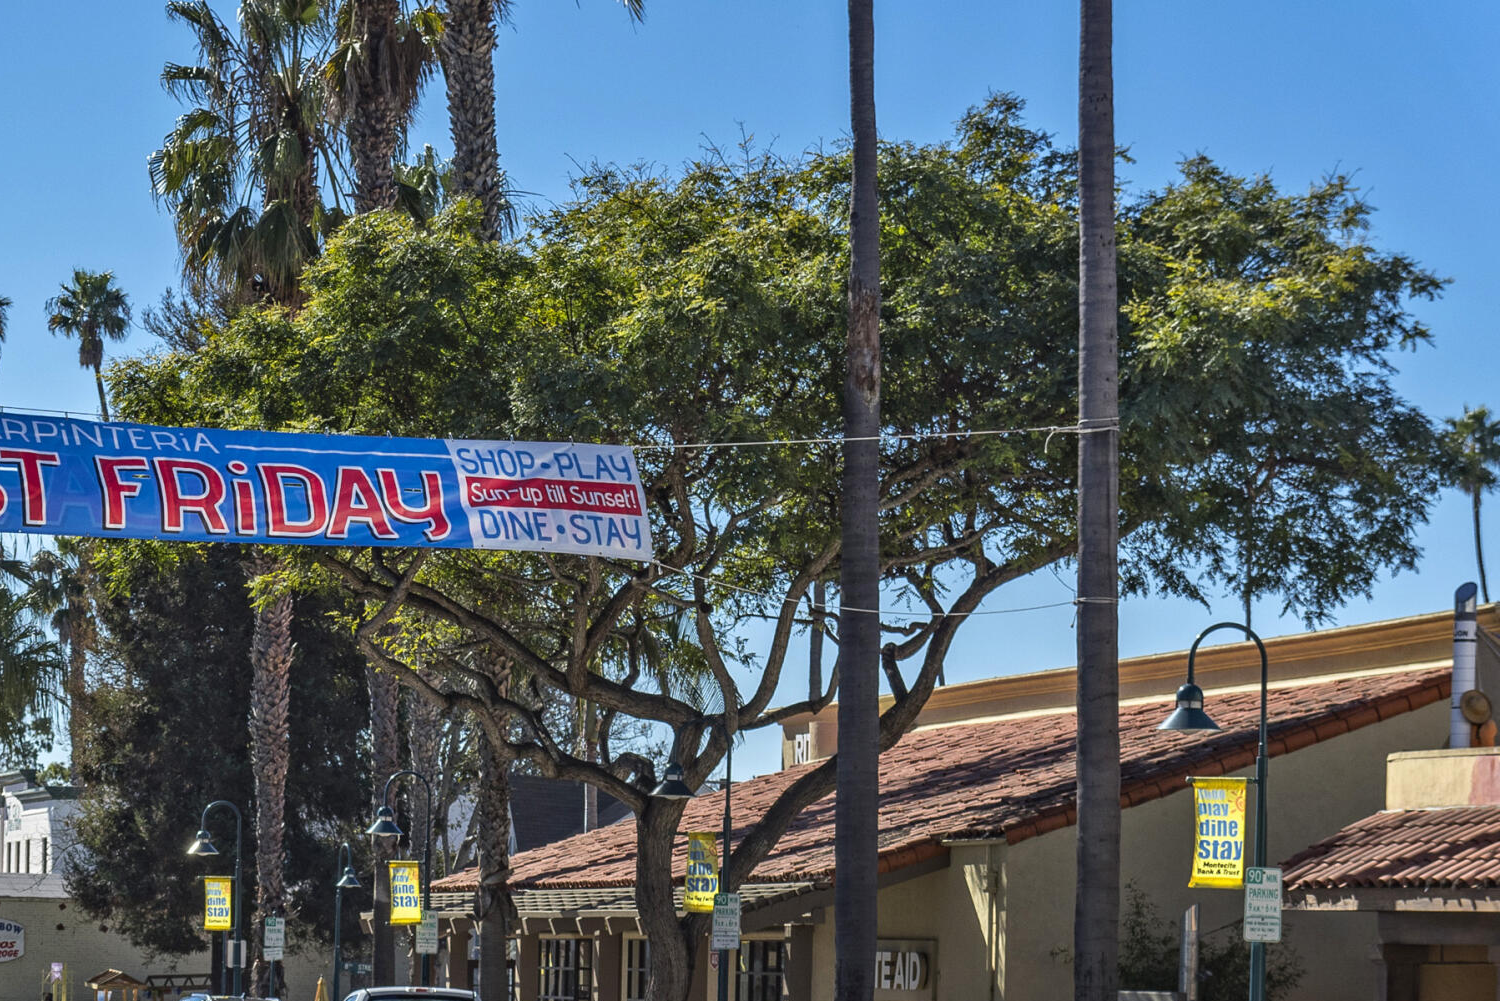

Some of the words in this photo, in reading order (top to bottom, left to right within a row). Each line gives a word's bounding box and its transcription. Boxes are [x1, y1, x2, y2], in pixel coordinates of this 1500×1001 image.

[456, 448, 535, 477] SHOP
[554, 452, 633, 482] PLAY
[470, 482, 544, 506] Sun-up
[546, 484, 567, 503] till
[571, 485, 637, 509] Sunset!
[479, 510, 553, 542] DINE
[569, 514, 642, 551] STAY
[1200, 819, 1238, 837] dine
[1199, 839, 1242, 861] stay
[1248, 869, 1261, 882] 90
[1249, 887, 1279, 899] PARKING
[893, 951, 921, 990] AID
